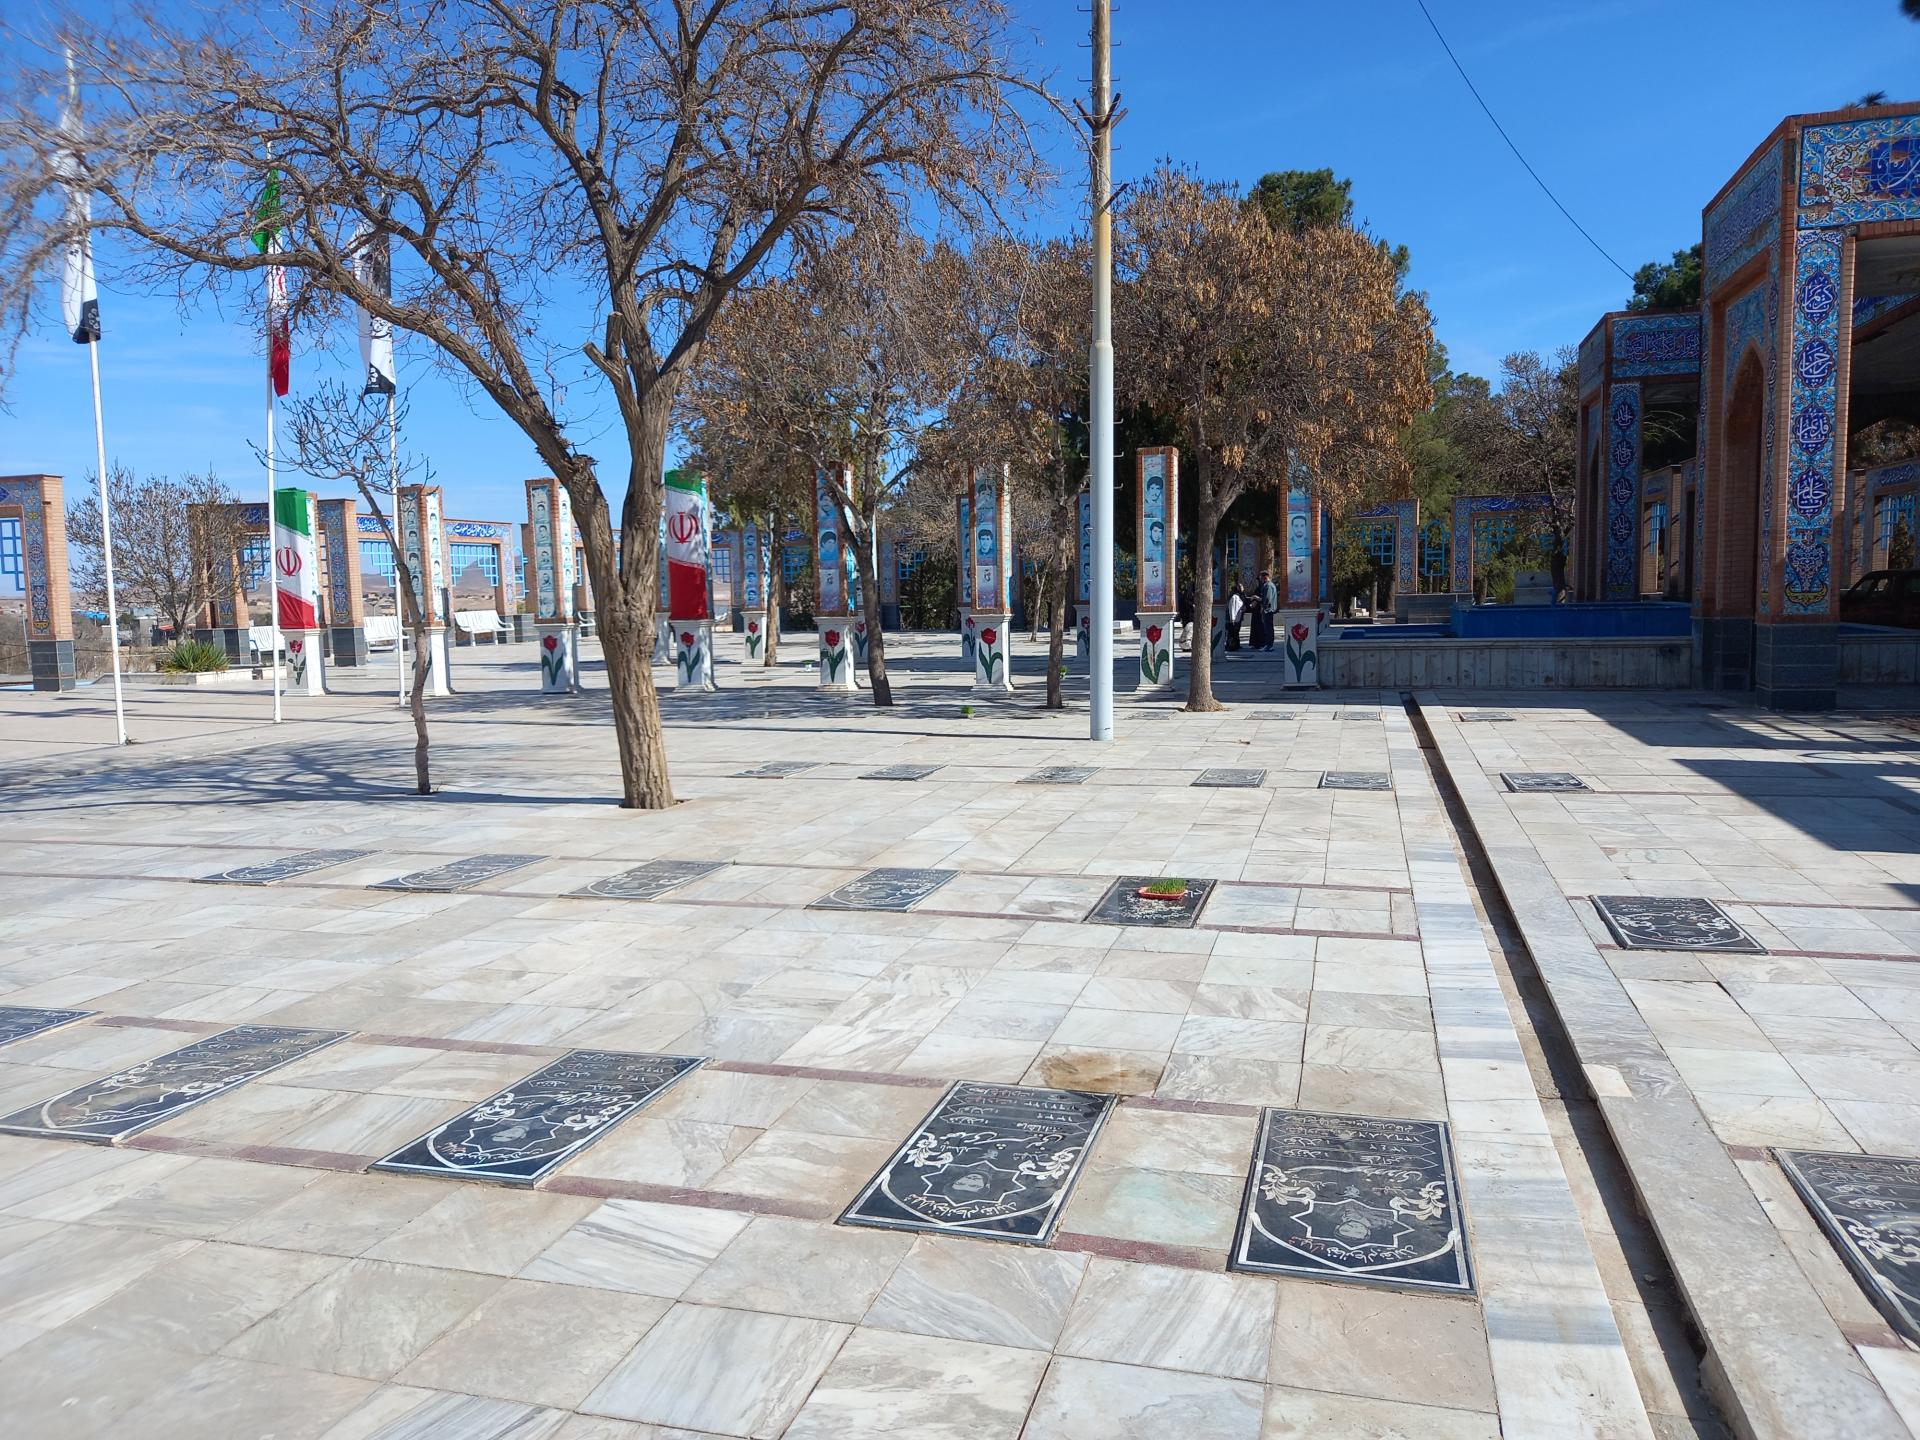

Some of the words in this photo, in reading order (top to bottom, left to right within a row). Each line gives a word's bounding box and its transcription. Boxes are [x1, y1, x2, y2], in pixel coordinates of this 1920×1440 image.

[974, 1131, 1061, 1153] شریفی
[1291, 1180, 1337, 1190] پاسدار
[1371, 1185, 1413, 1198] شهید
